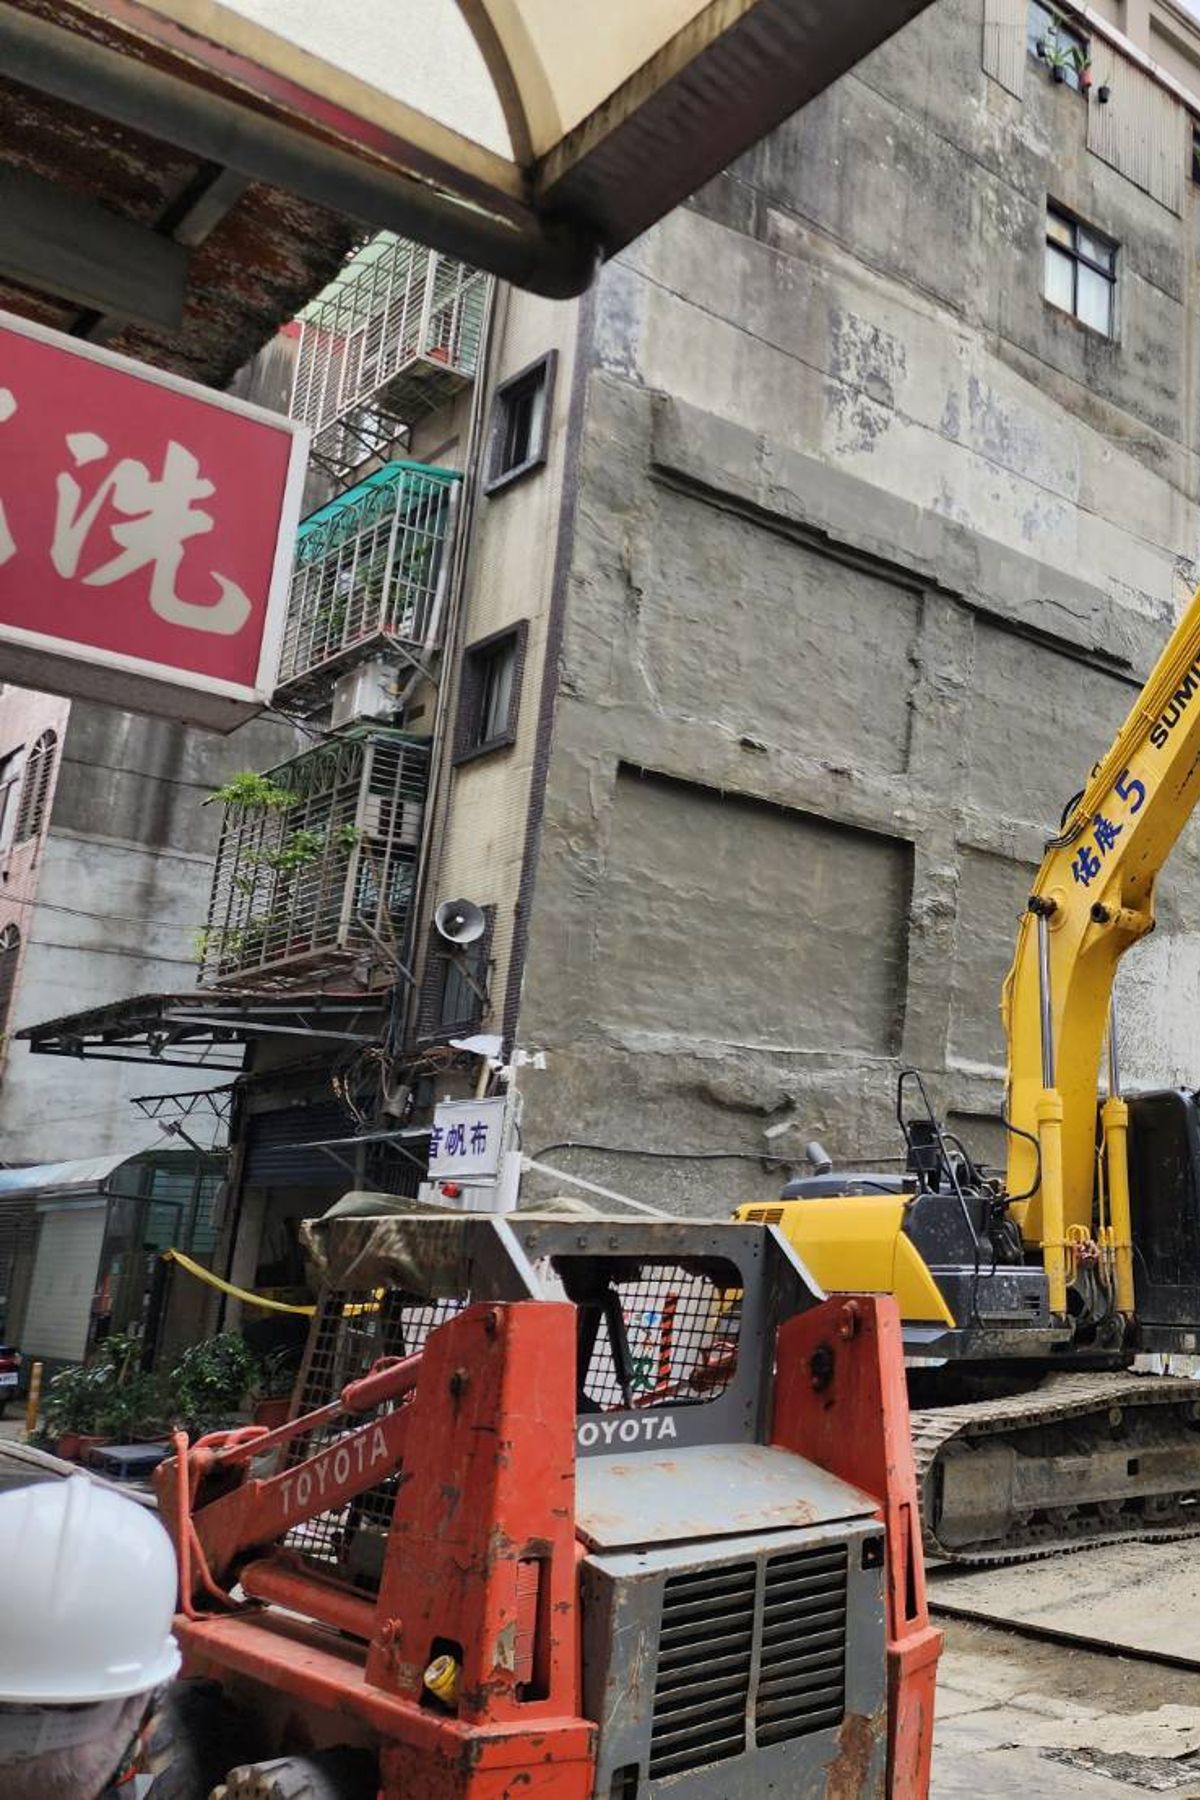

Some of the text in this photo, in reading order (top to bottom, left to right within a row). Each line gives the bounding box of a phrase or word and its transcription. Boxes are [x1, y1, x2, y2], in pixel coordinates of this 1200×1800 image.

[0, 388, 252, 635] 洗
[1114, 768, 1147, 815] 5
[575, 1414, 677, 1447] OYOTA
[279, 1427, 388, 1515] TOYOTA
